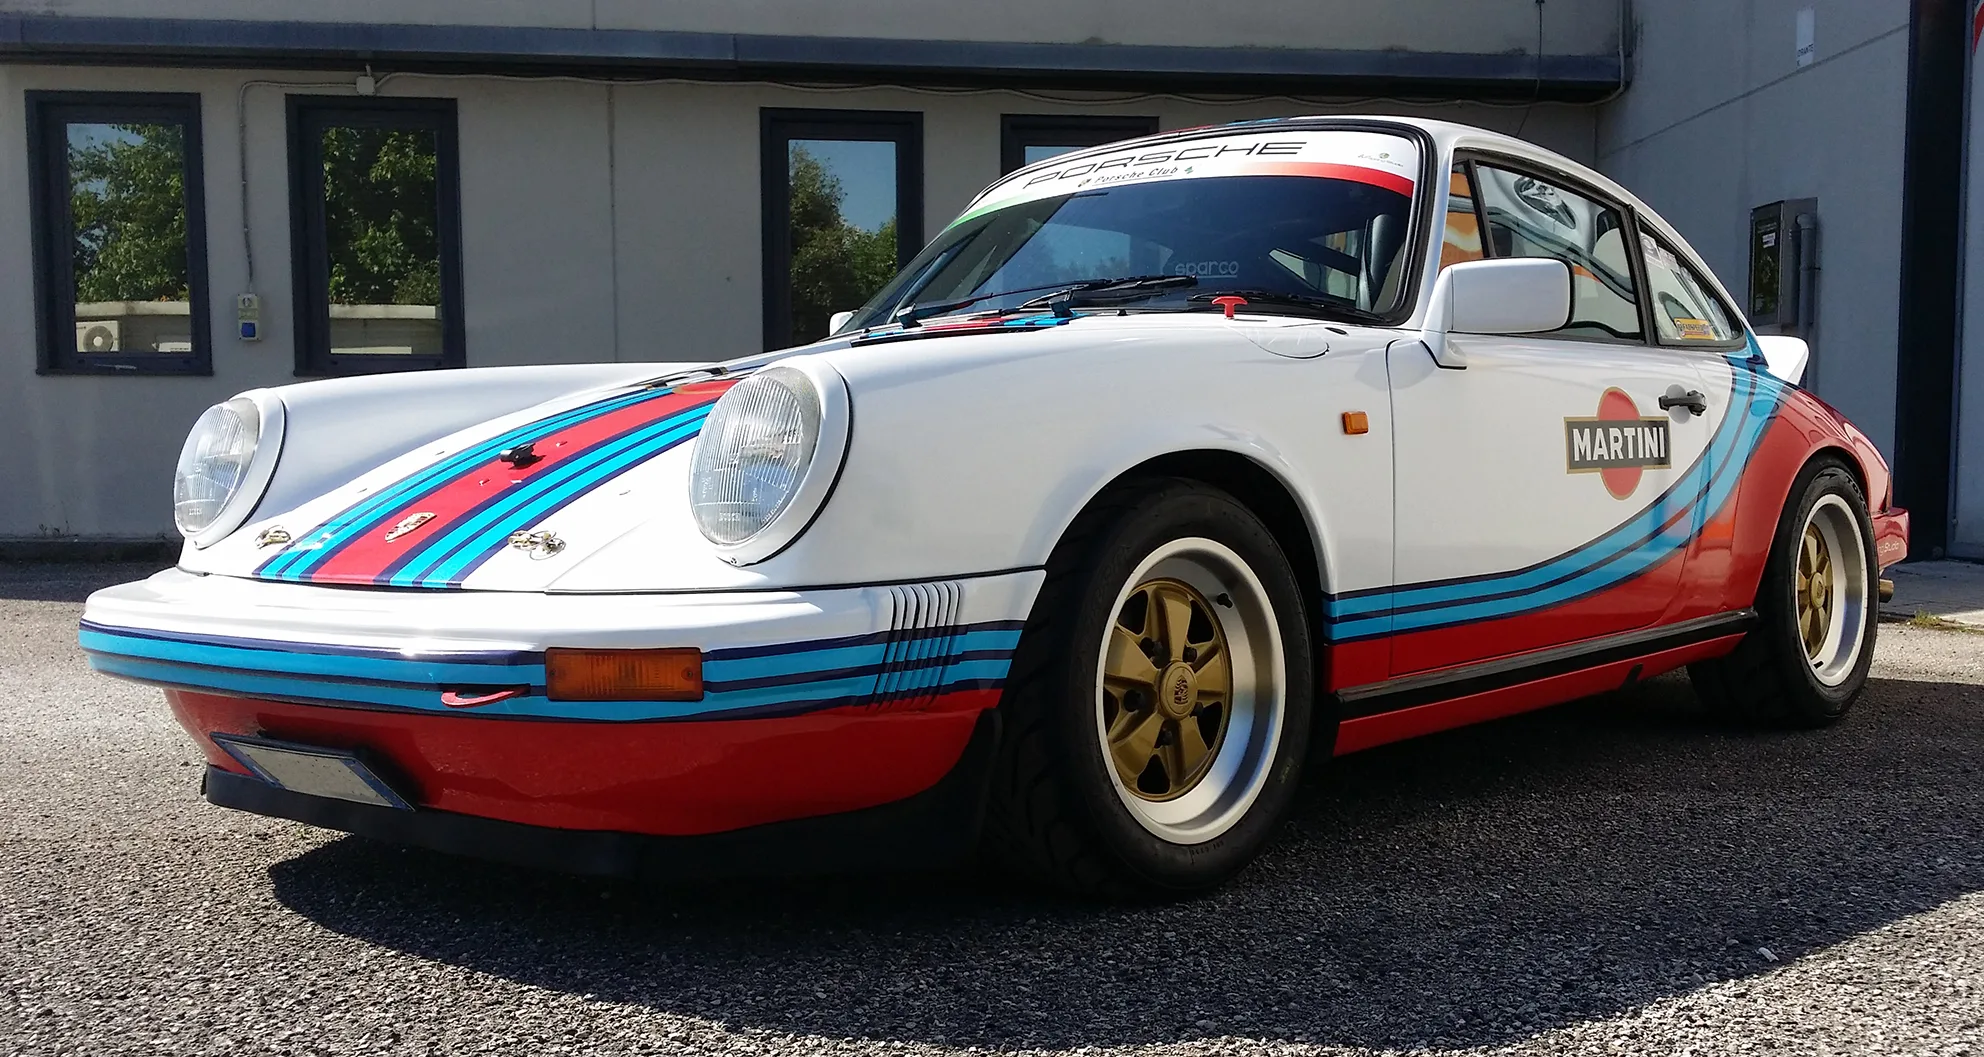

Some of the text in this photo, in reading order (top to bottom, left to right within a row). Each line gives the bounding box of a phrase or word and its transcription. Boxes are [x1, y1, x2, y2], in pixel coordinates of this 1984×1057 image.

[1022, 141, 1307, 189] PORSCHE
[1094, 166, 1178, 183] Porsche Club
[1174, 260, 1240, 277] sparco
[1572, 426, 1666, 462] MARTINI
